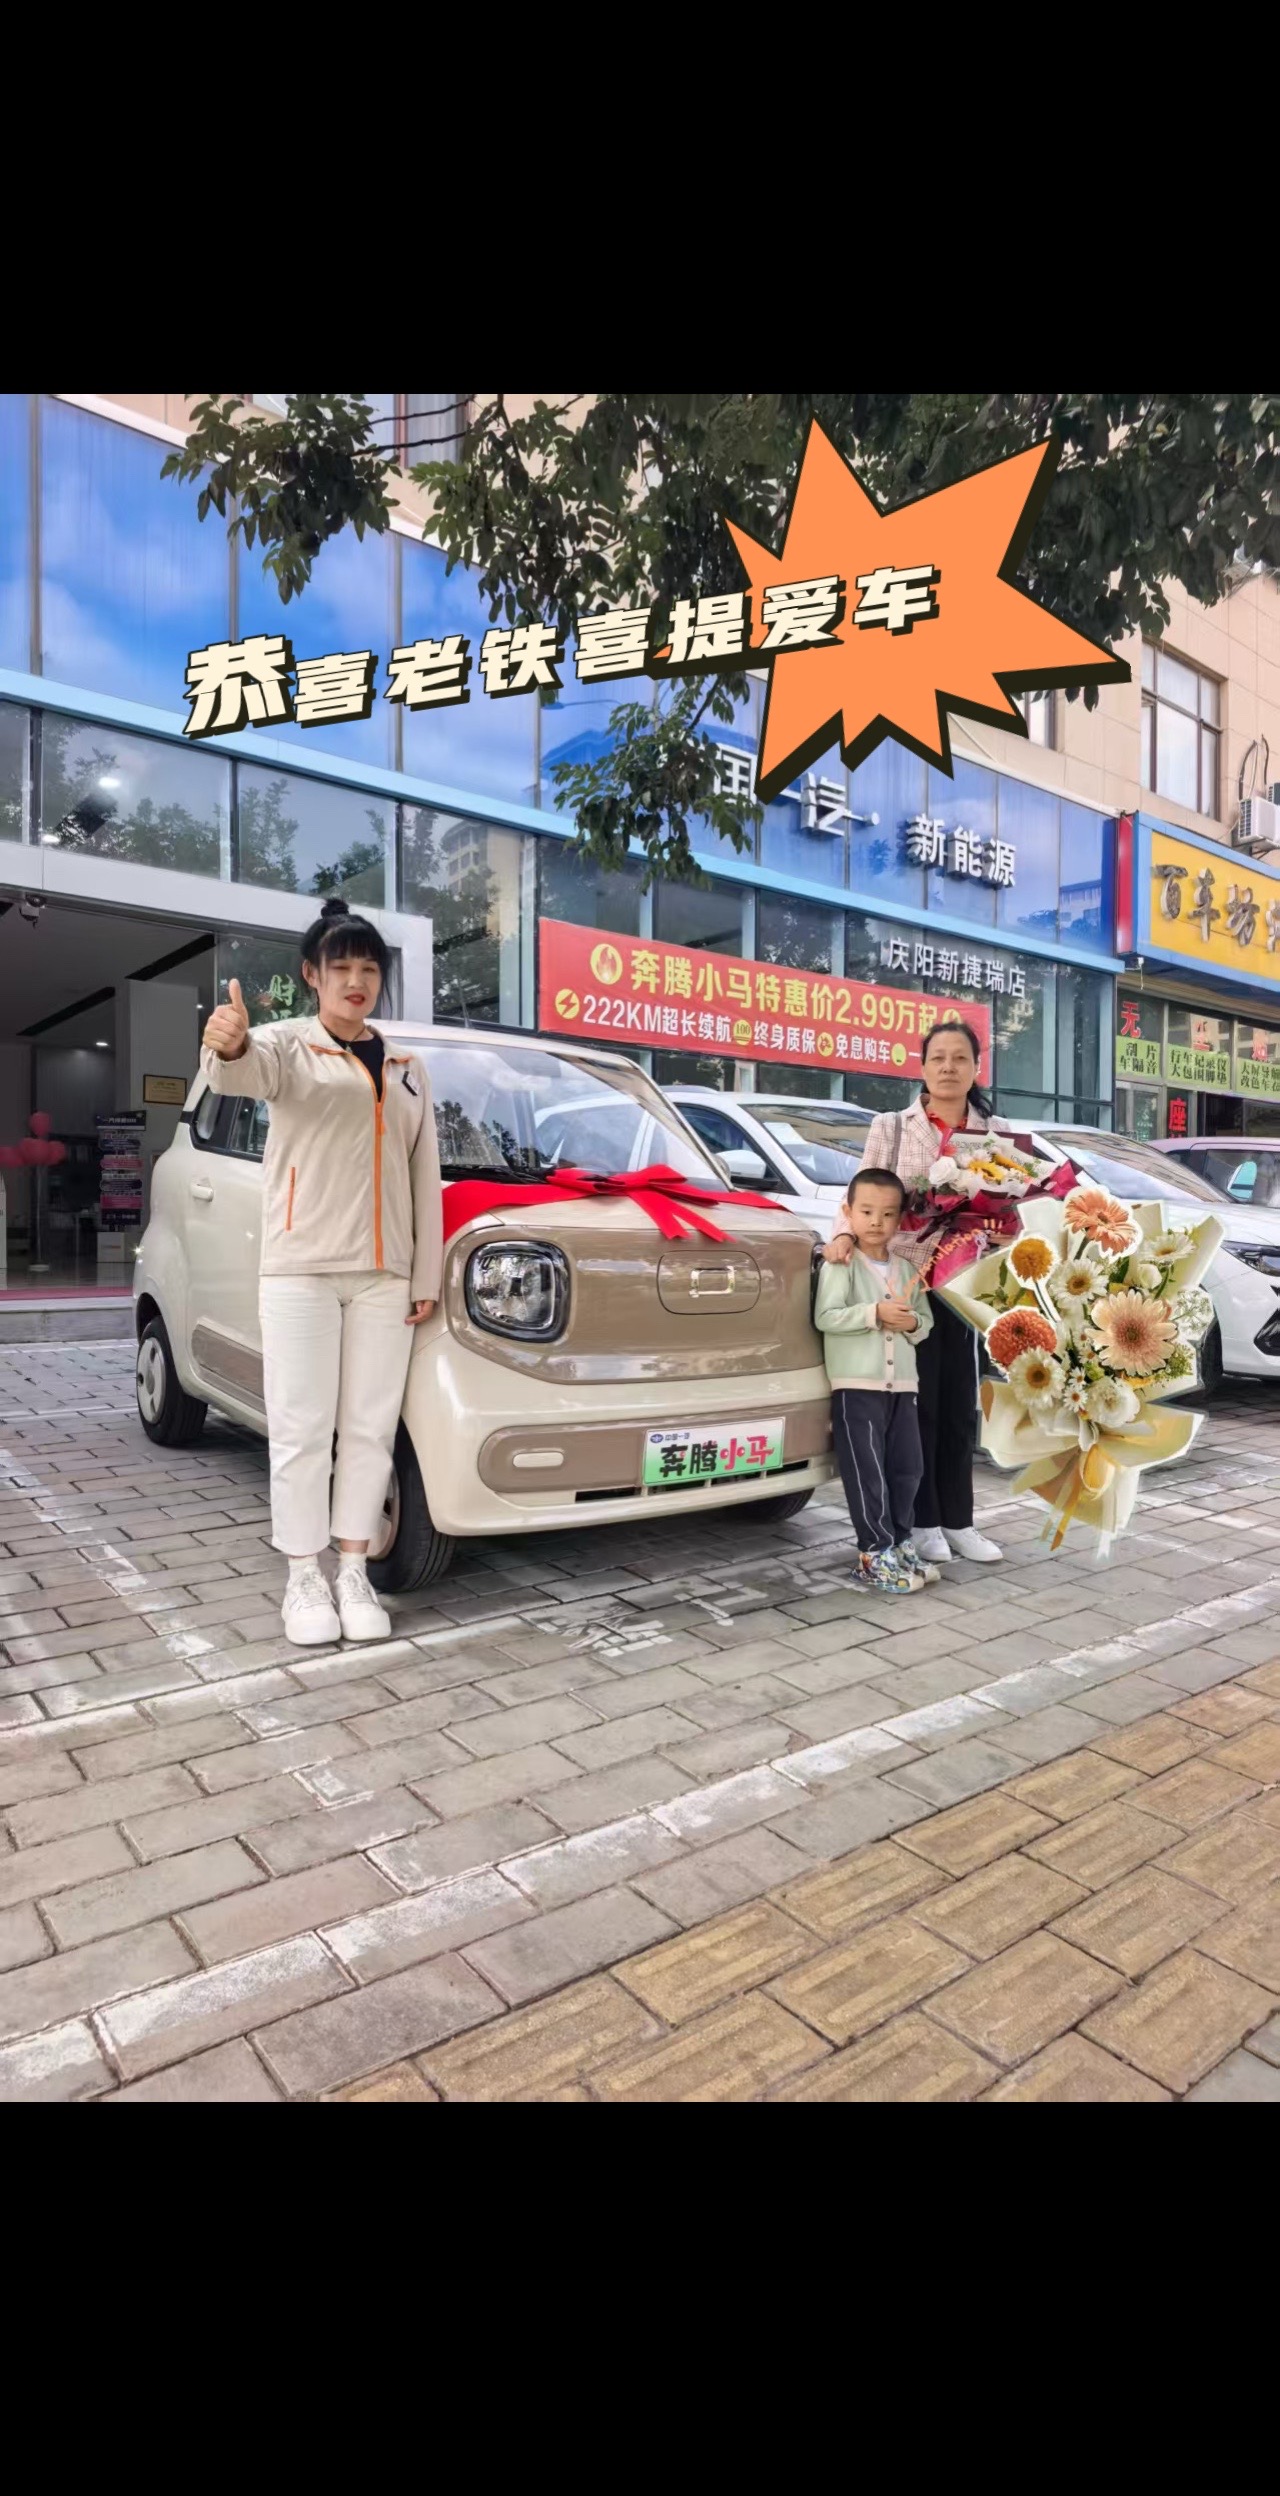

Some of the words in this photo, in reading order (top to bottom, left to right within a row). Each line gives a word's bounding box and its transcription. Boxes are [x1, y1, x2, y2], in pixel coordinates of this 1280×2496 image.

[887, 937, 1026, 998] 庆阳新捷瑞店
[582, 994, 732, 1043] 222KM超长续航
[754, 1020, 816, 1054] 终身质保
[835, 1032, 891, 1064] 免息购车
[659, 1435, 775, 1478] 奔腾小马
